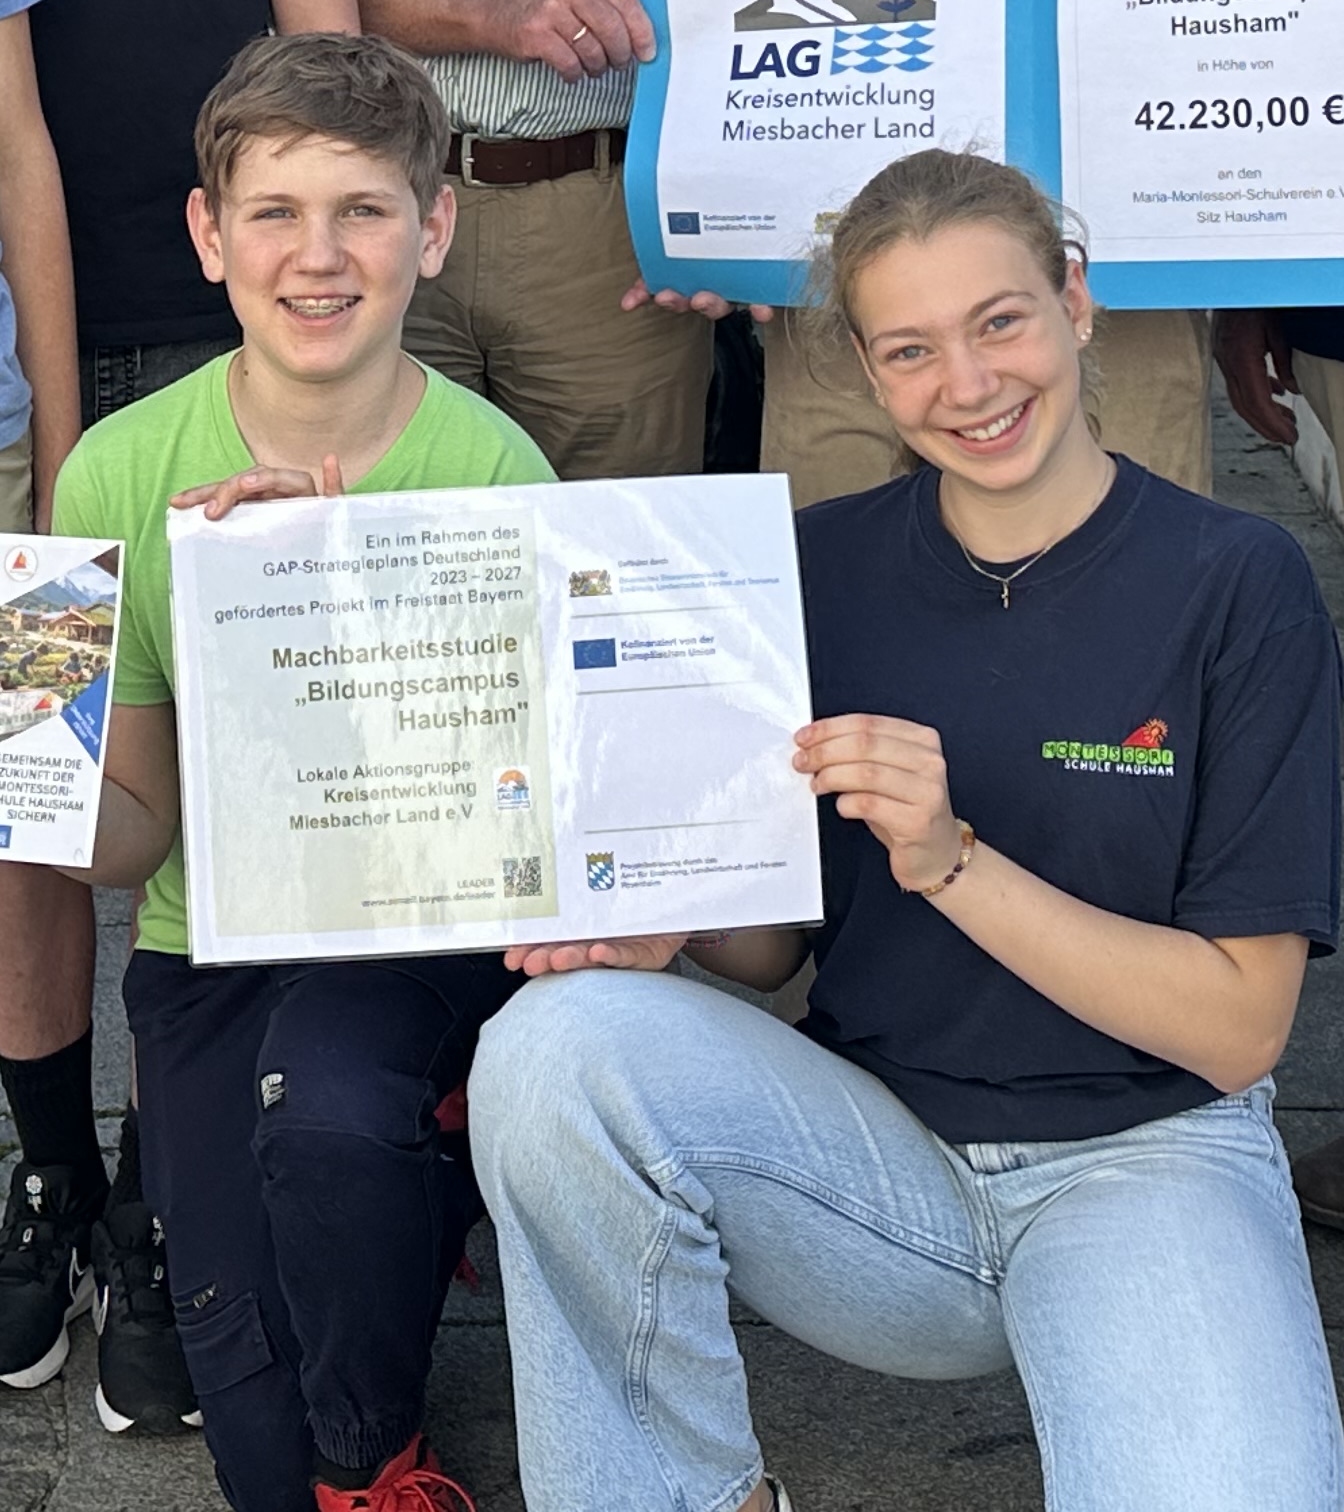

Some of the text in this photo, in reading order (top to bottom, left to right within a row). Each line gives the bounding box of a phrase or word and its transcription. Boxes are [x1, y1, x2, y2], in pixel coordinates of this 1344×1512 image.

[1170, 10, 1300, 37] Hausham"
[729, 39, 823, 81] LAG
[1197, 59, 1274, 72] in Höhe von
[725, 82, 935, 112] Kreisentwicklung
[1134, 95, 1310, 133] 42.230,00
[721, 114, 935, 142] Miesbacher Land
[1217, 167, 1262, 180] an den
[1196, 209, 1288, 223] Sitz Hausham
[365, 526, 521, 550] Ein im Rahmen des
[262, 546, 522, 578] GAP-Strategieplans Deutschland
[429, 570, 469, 586] 2023
[484, 566, 523, 582] 2027
[213, 588, 524, 625] gefördertes Projekt im Freistaat Bayern
[271, 633, 518, 670] Machbarkeitsstudie
[294, 670, 521, 708] „Bildungscampus
[398, 700, 529, 732] Hausham"
[64, 758, 83, 770] DIE
[1043, 742, 1173, 765] MONTESSORI
[52, 771, 75, 784] DER
[296, 768, 349, 783] Lokale
[1064, 759, 1174, 777] SCHULE HAUSHAM
[28, 796, 84, 812] HAUSHAM
[323, 780, 477, 804] Kreisentwicklung
[6, 808, 57, 823] SICHERN
[289, 812, 392, 831] Miesbacher
[395, 806, 441, 824] Land
